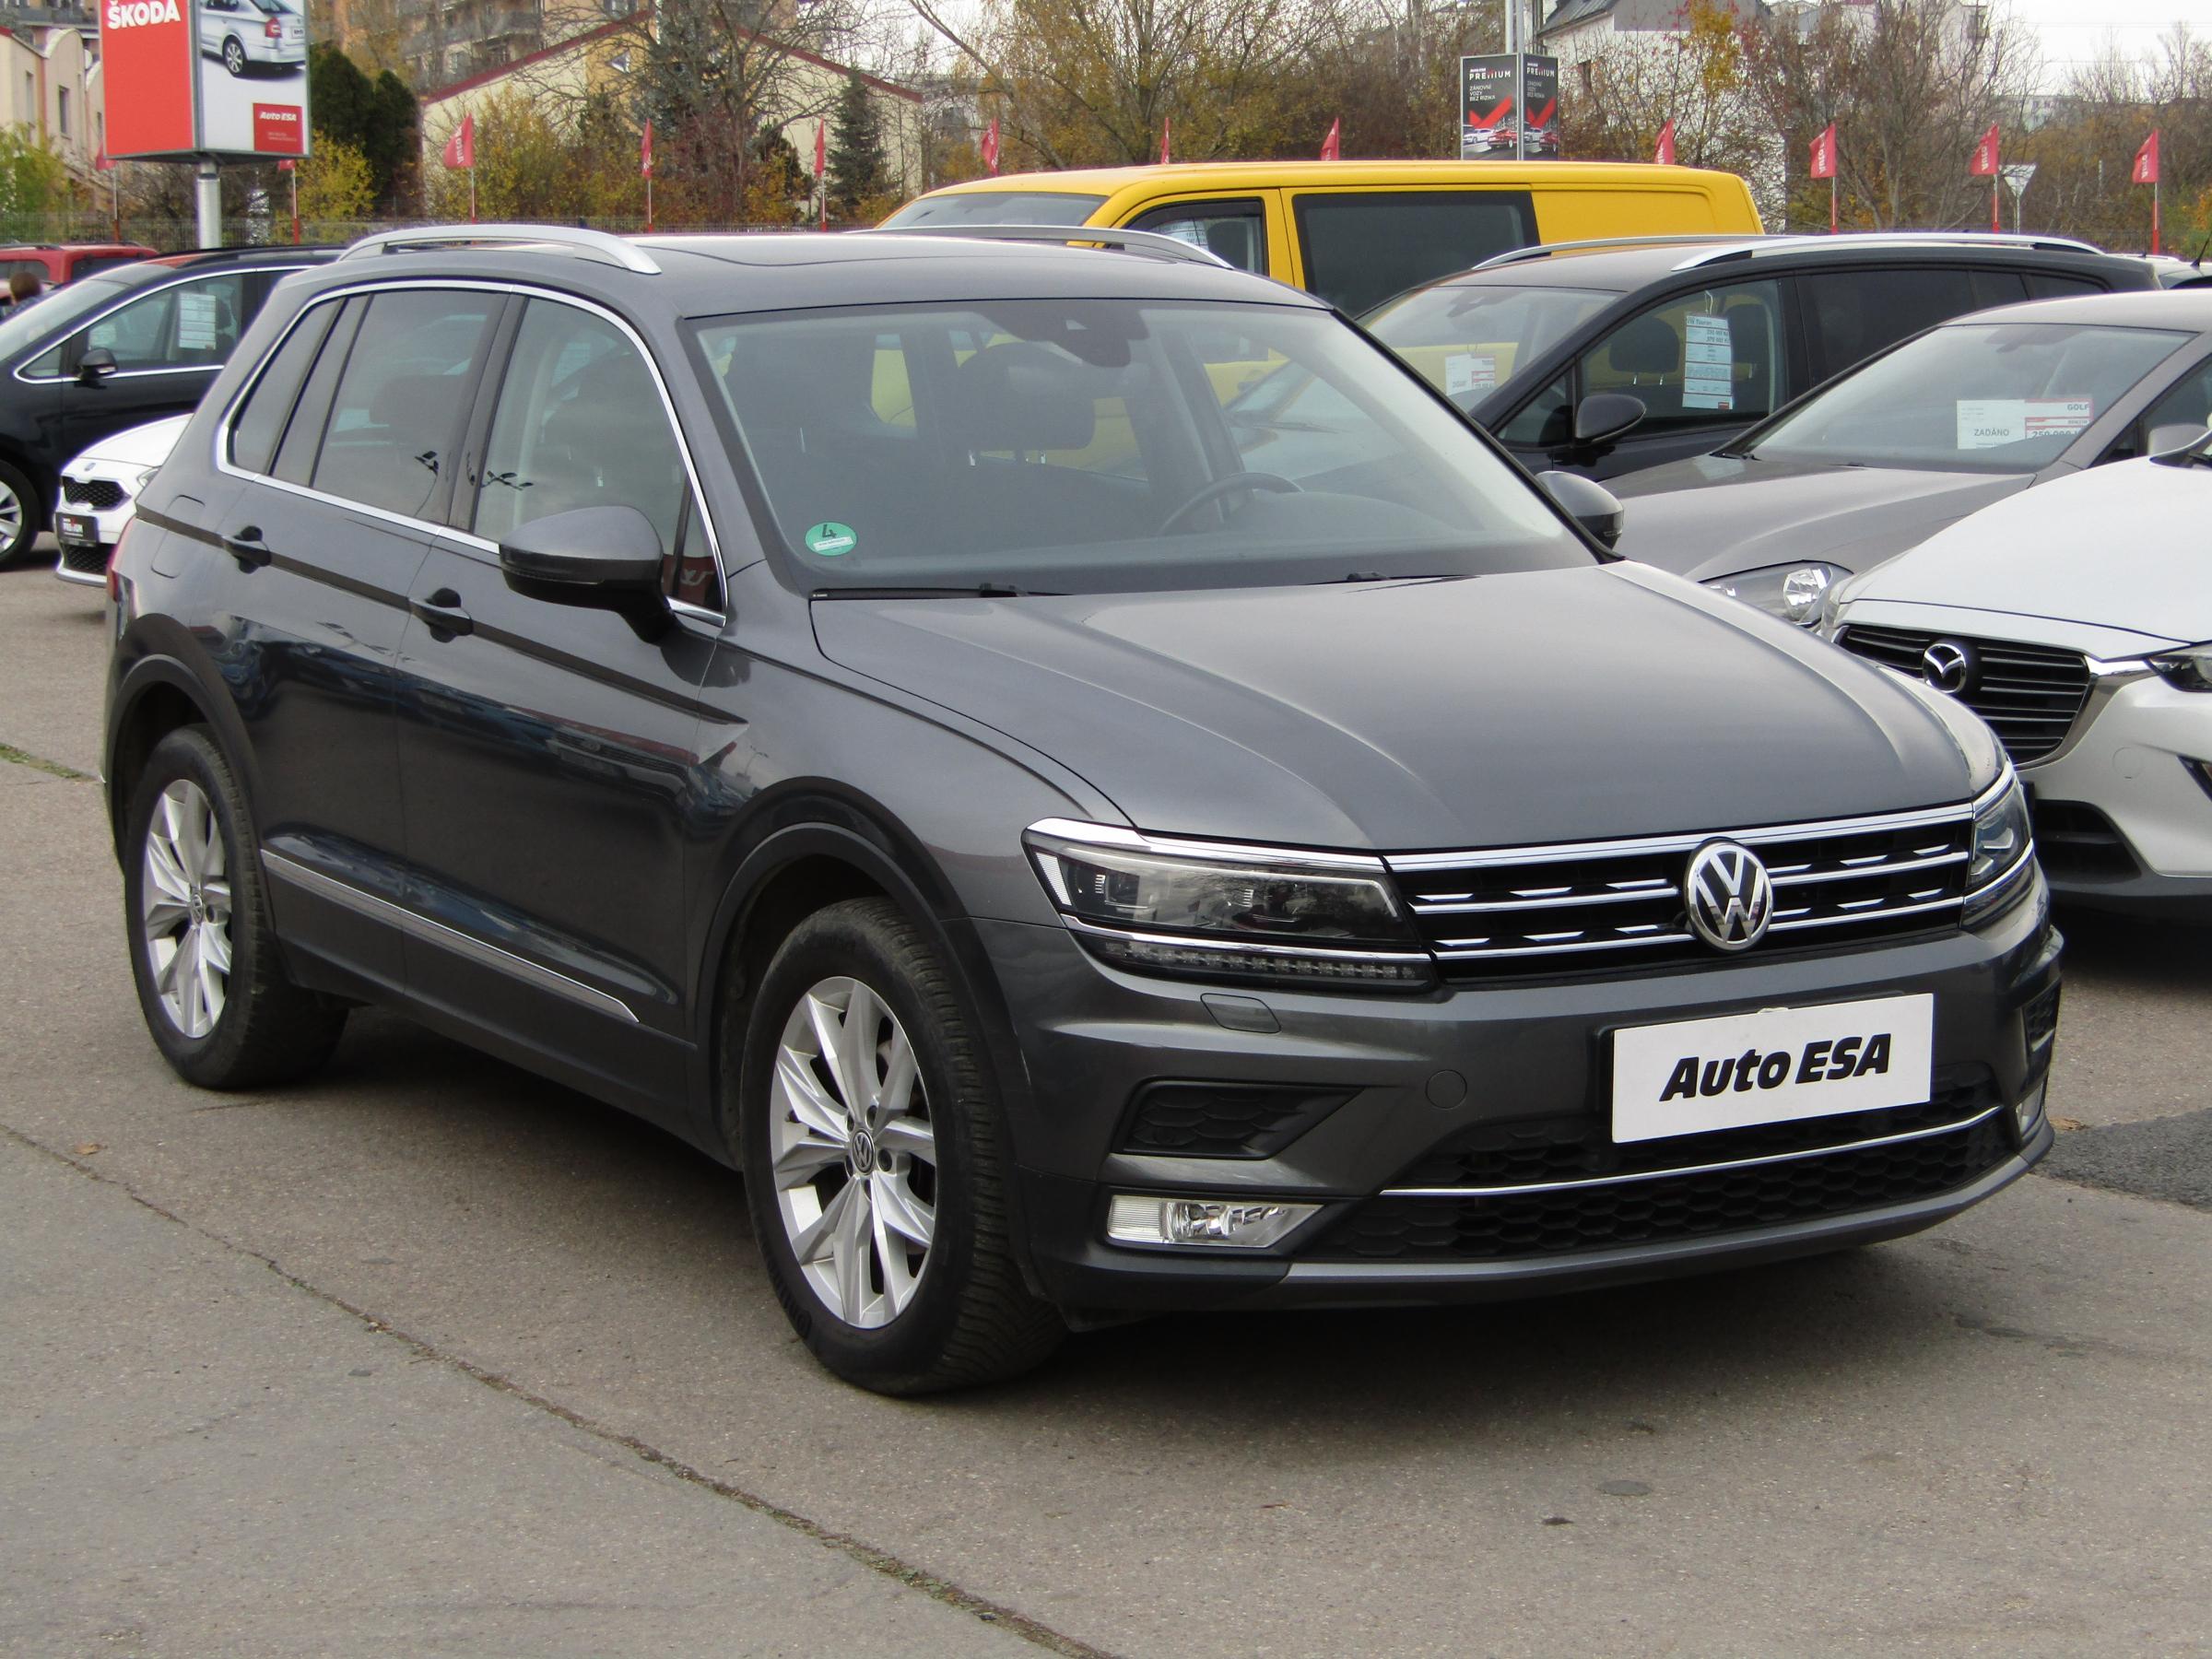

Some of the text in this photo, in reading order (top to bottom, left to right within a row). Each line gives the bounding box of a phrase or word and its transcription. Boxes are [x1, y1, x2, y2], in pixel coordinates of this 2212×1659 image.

[108, 0, 181, 29] ŠKODA
[1974, 428, 2009, 436] ZADÁNO
[822, 524, 836, 537] 4
[1659, 1033, 1891, 1101] Auto ESA
